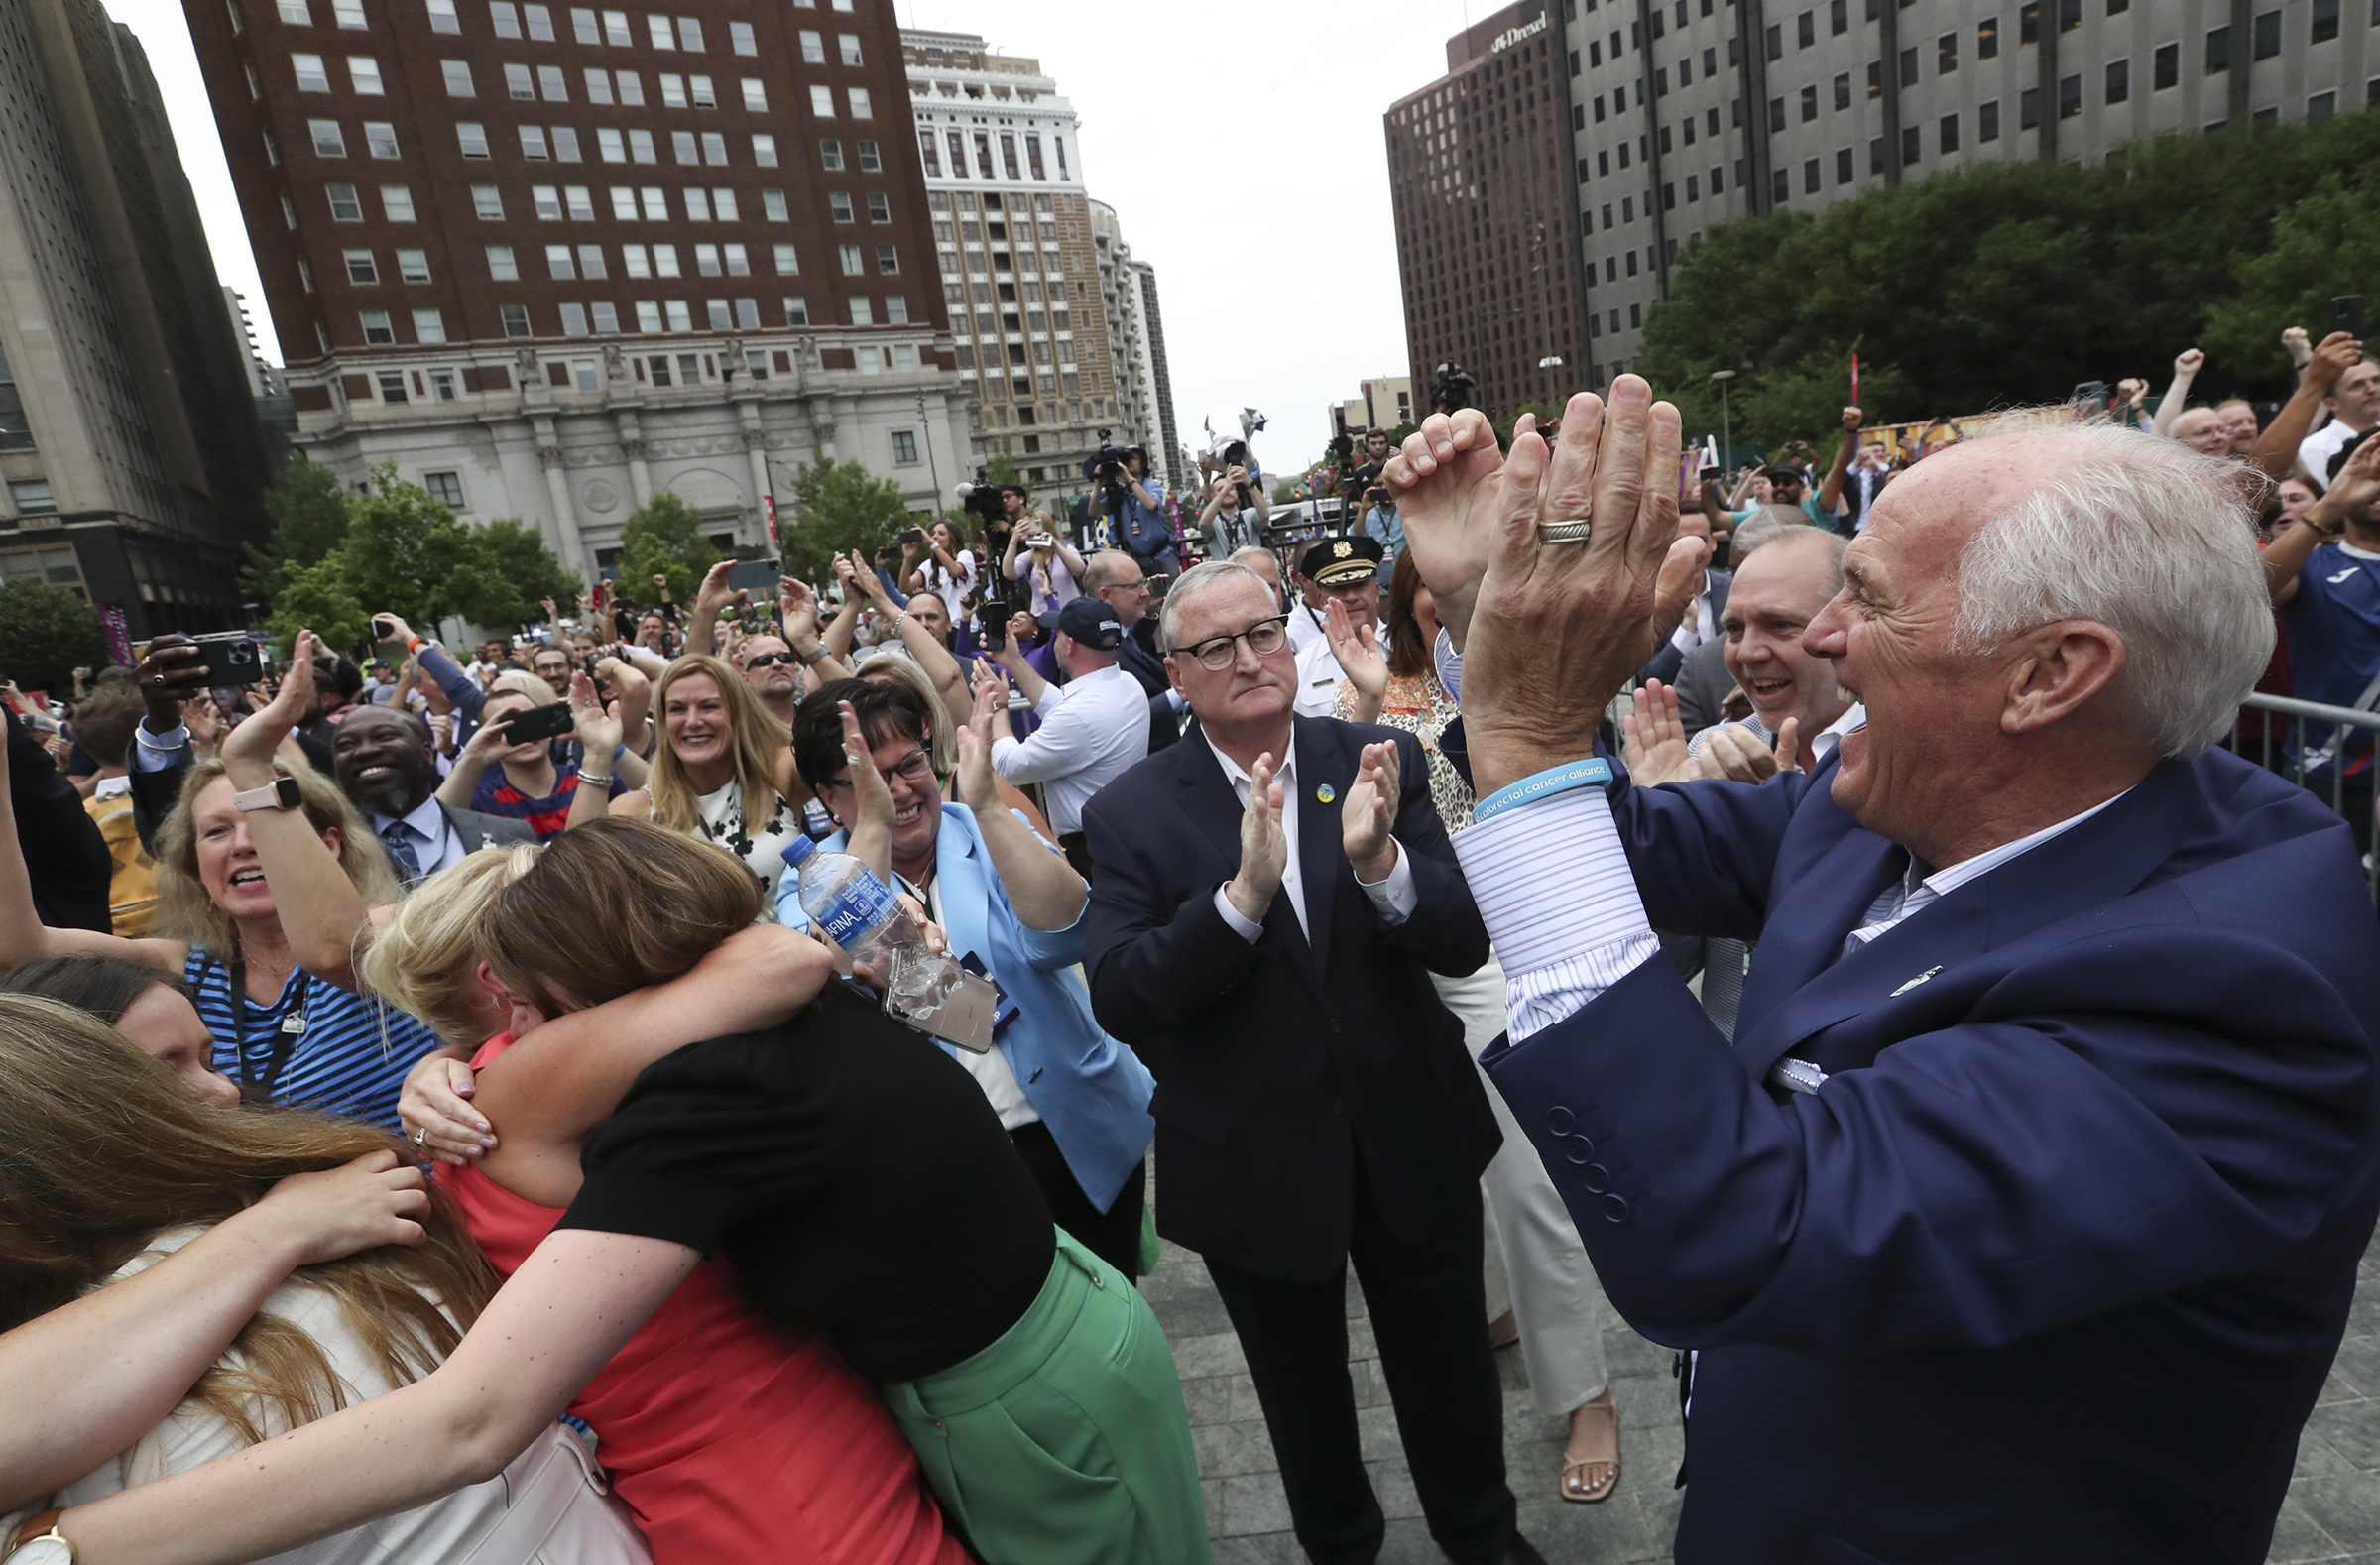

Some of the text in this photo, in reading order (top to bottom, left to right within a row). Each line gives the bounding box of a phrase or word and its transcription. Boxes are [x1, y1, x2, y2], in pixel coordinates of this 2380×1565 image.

[1480, 765, 1606, 820] colorectal cancer alliance
[825, 910, 858, 937] AFINA
